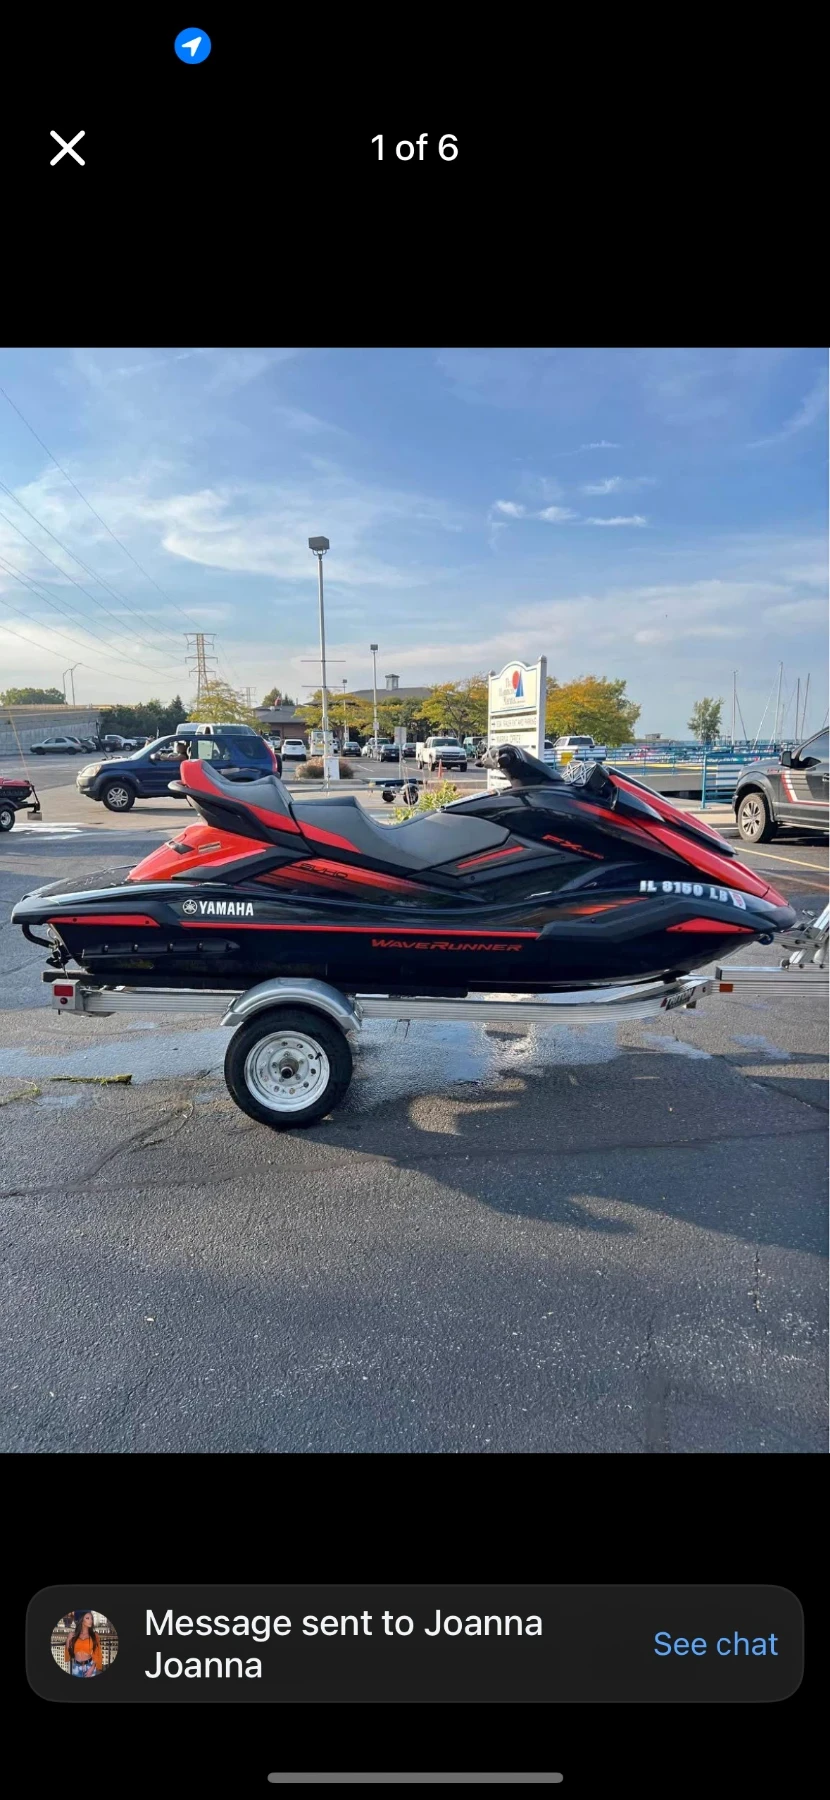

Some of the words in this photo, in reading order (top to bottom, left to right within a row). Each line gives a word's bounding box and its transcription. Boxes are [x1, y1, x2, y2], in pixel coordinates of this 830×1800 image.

[639, 880, 657, 893] IL
[709, 887, 729, 902] LB
[199, 900, 254, 916] YAMAHA
[371, 938, 523, 952] WAVERUNNER
